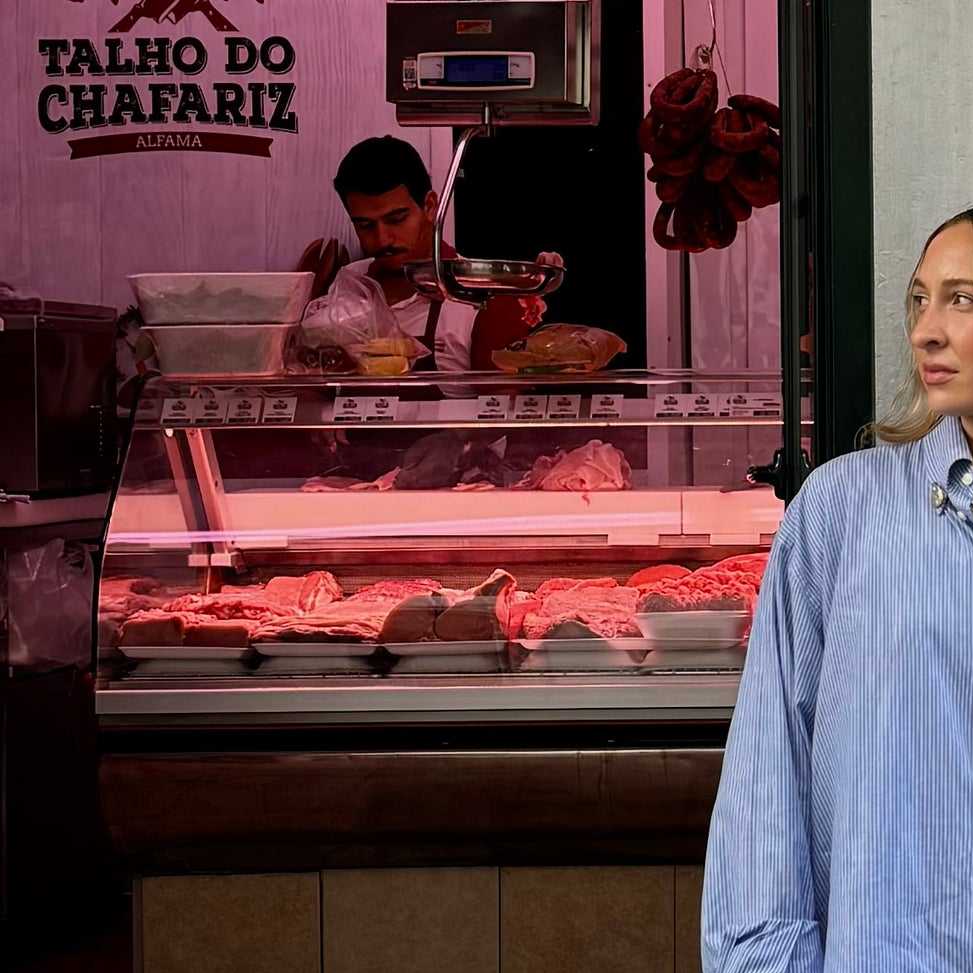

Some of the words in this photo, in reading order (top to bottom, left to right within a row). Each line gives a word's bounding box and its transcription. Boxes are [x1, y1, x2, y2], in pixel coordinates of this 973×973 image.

[38, 36, 208, 76] TALHO
[224, 35, 296, 75] DO
[37, 82, 299, 134] CHAFARIZ
[136, 134, 203, 149] ALFAMA
